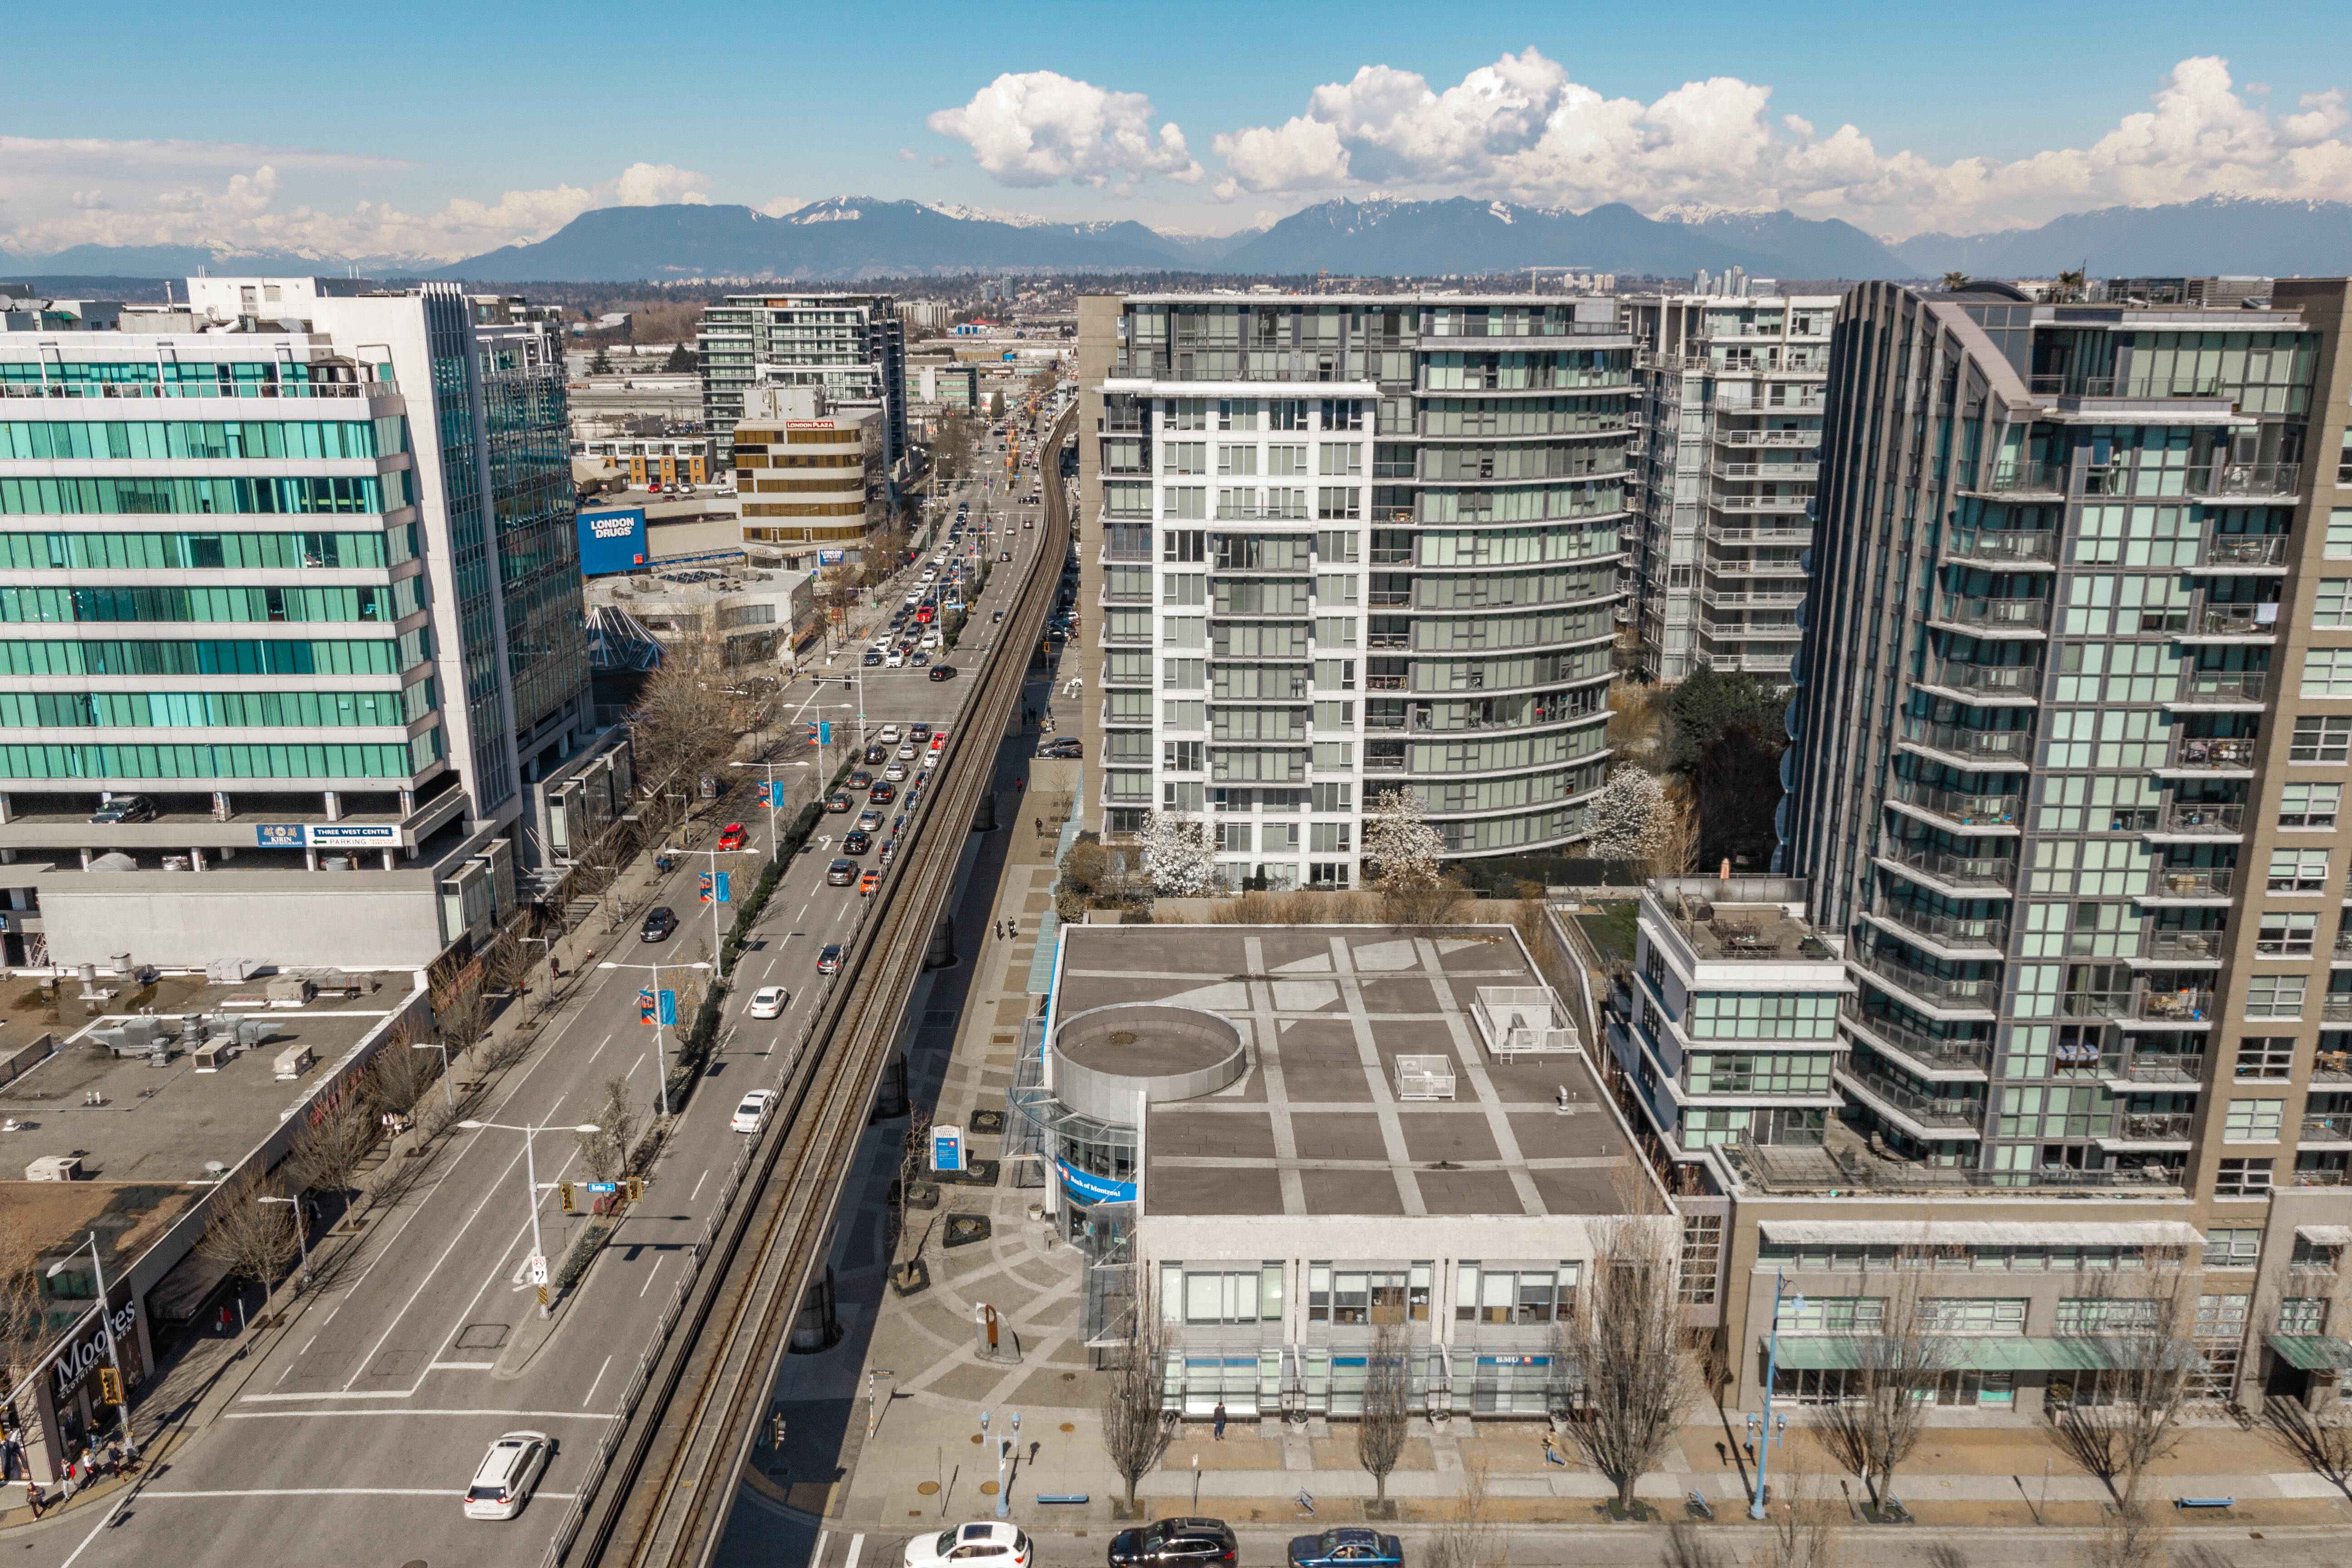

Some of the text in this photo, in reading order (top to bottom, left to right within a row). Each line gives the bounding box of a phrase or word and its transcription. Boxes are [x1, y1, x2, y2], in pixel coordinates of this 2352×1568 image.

[591, 517, 634, 530] LONDON
[595, 527, 632, 539] DRUGS
[1071, 1176, 1083, 1187] Bank
[1090, 1185, 1121, 1197] Montreal
[61, 1359, 99, 1399] CLOTHING
[117, 1325, 132, 1342] MEN
